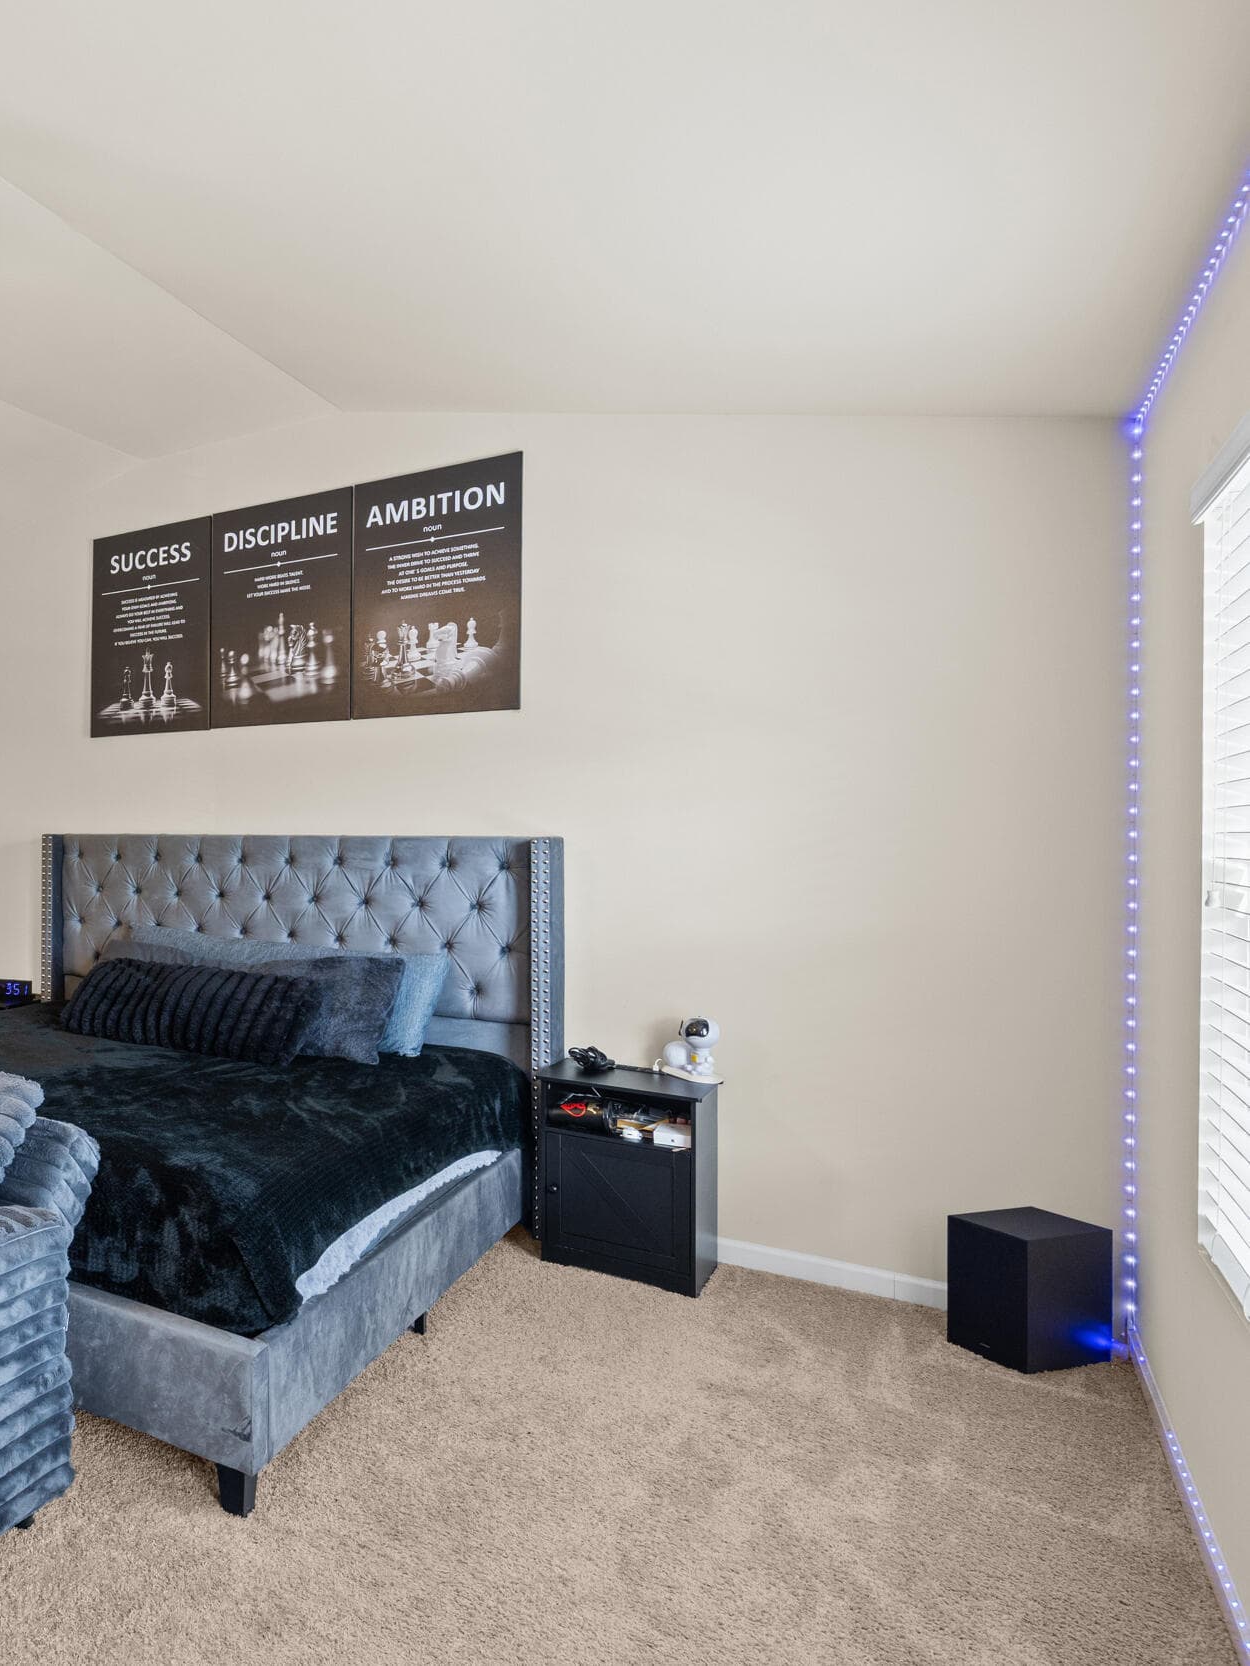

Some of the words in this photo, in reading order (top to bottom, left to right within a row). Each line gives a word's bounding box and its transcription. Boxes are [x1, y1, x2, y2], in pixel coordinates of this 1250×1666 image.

[366, 481, 505, 528] AMBITION
[224, 512, 338, 553] DISCIPLINE
[422, 523, 442, 533] noun
[110, 541, 191, 575] SUCCESS
[271, 550, 287, 558] noun
